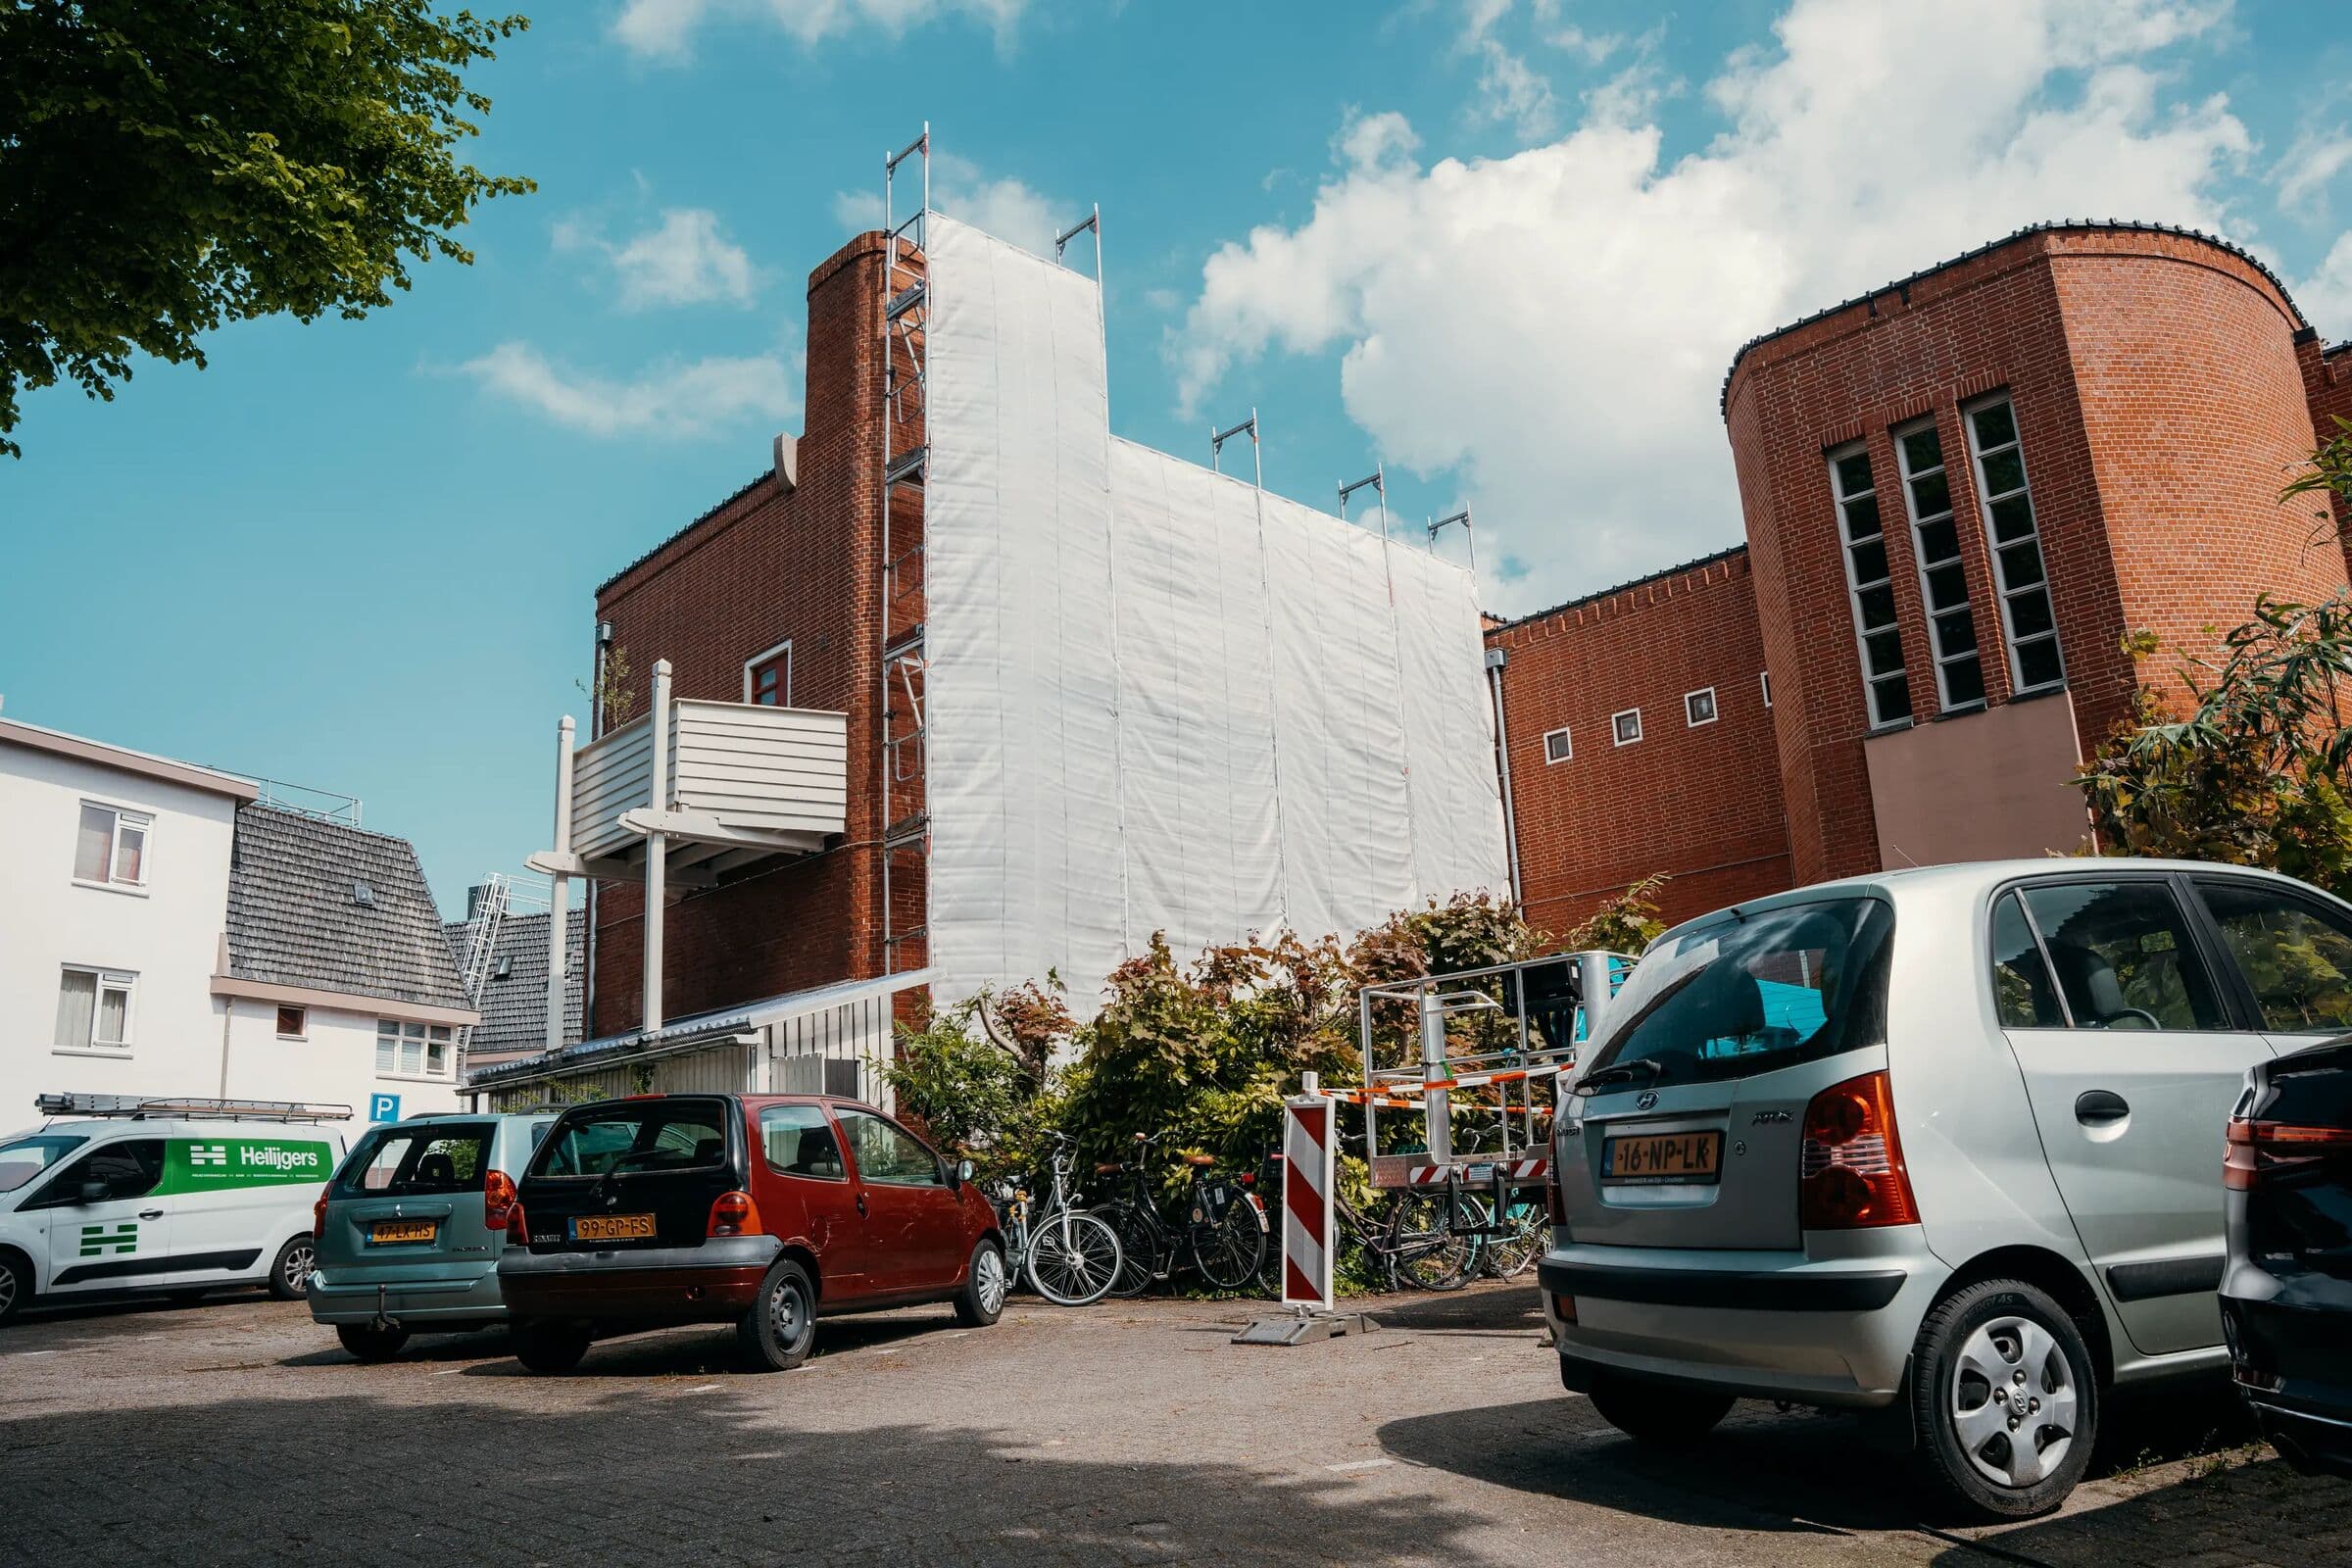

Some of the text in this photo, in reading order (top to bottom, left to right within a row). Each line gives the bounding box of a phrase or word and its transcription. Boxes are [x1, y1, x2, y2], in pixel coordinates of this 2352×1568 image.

[376, 1097, 394, 1119] P
[240, 1146, 318, 1170] Heilijgers
[1623, 1138, 1709, 1172] 16-NP-LK
[376, 1224, 431, 1240] 47-LX-HS
[581, 1217, 650, 1237] 99-GP-FS
